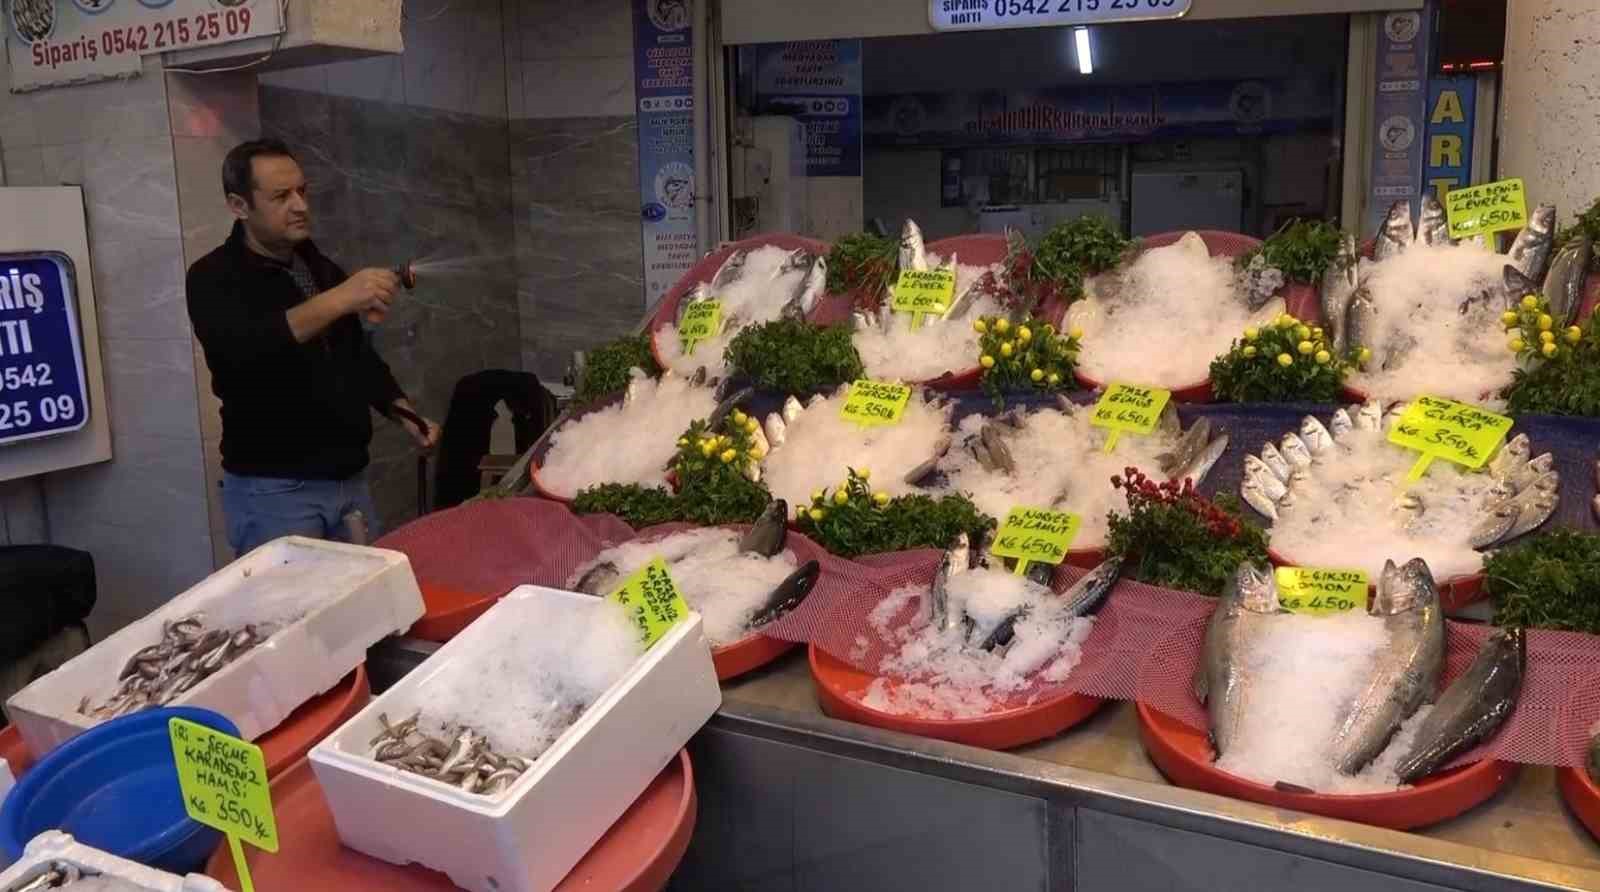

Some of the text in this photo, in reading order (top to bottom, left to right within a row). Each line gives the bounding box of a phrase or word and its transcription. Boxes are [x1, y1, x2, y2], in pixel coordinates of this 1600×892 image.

[951, 12, 982, 25] HATTI
[32, 7, 251, 69] Sipariş 0542 215 25 09
[1453, 194, 1515, 211] LEVREK
[40, 394, 75, 423] 09
[1007, 514, 1072, 535] PALAMUT
[184, 746, 261, 786] KARADENİZ
[196, 769, 247, 798] HAMSİ
